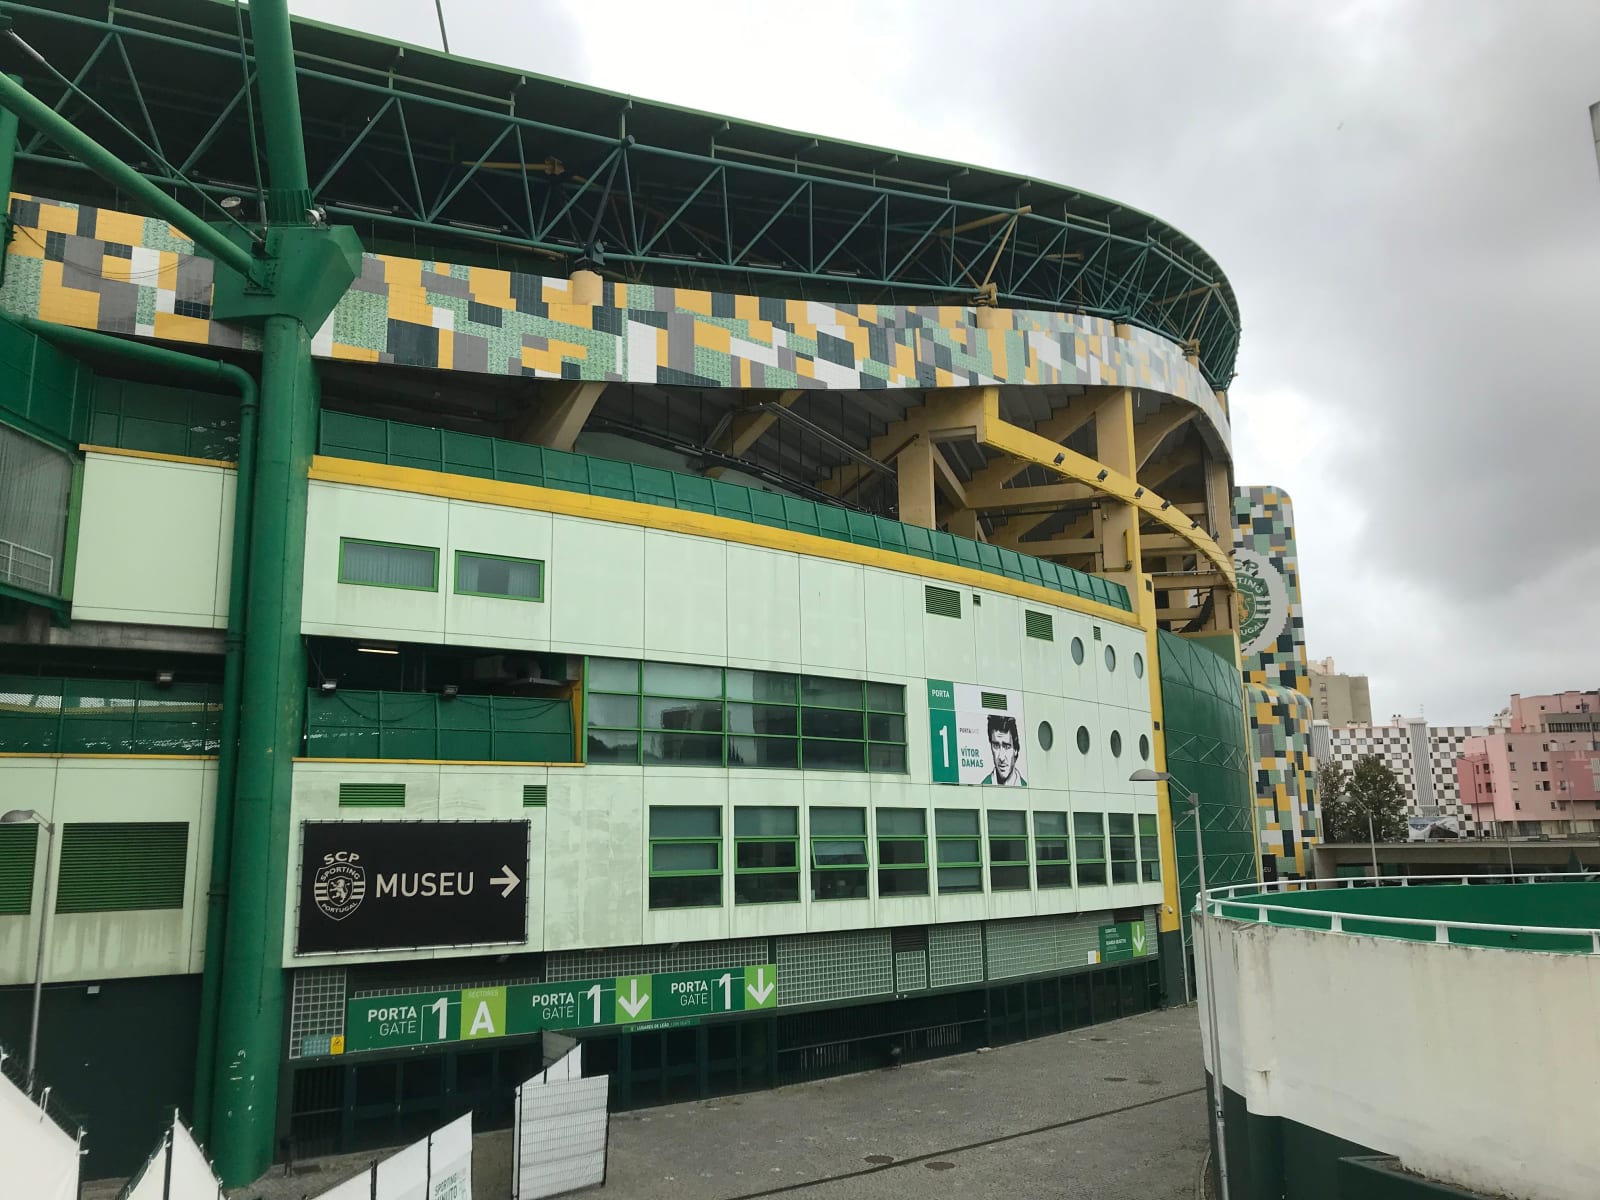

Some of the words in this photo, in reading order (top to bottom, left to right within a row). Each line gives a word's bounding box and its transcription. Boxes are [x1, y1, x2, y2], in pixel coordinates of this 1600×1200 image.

[931, 689, 950, 698] PORTA
[939, 725, 950, 768] 1
[961, 746, 980, 758] VÍTOR
[961, 758, 984, 768] DAMAS
[323, 851, 360, 865] SCP
[320, 866, 361, 882] SPORTING
[376, 871, 474, 898] MUSEU
[321, 901, 358, 913] PORTUGAL
[671, 980, 708, 994] PORTA
[718, 973, 731, 1010] 1
[532, 992, 575, 1008] PORTA
[587, 984, 601, 1024] 1
[680, 992, 708, 1006] GATE
[368, 1006, 417, 1022] PORTA
[431, 997, 448, 1040] 1
[469, 1001, 496, 1036] A
[542, 1005, 575, 1020] GATE
[379, 1020, 417, 1036] GATE
